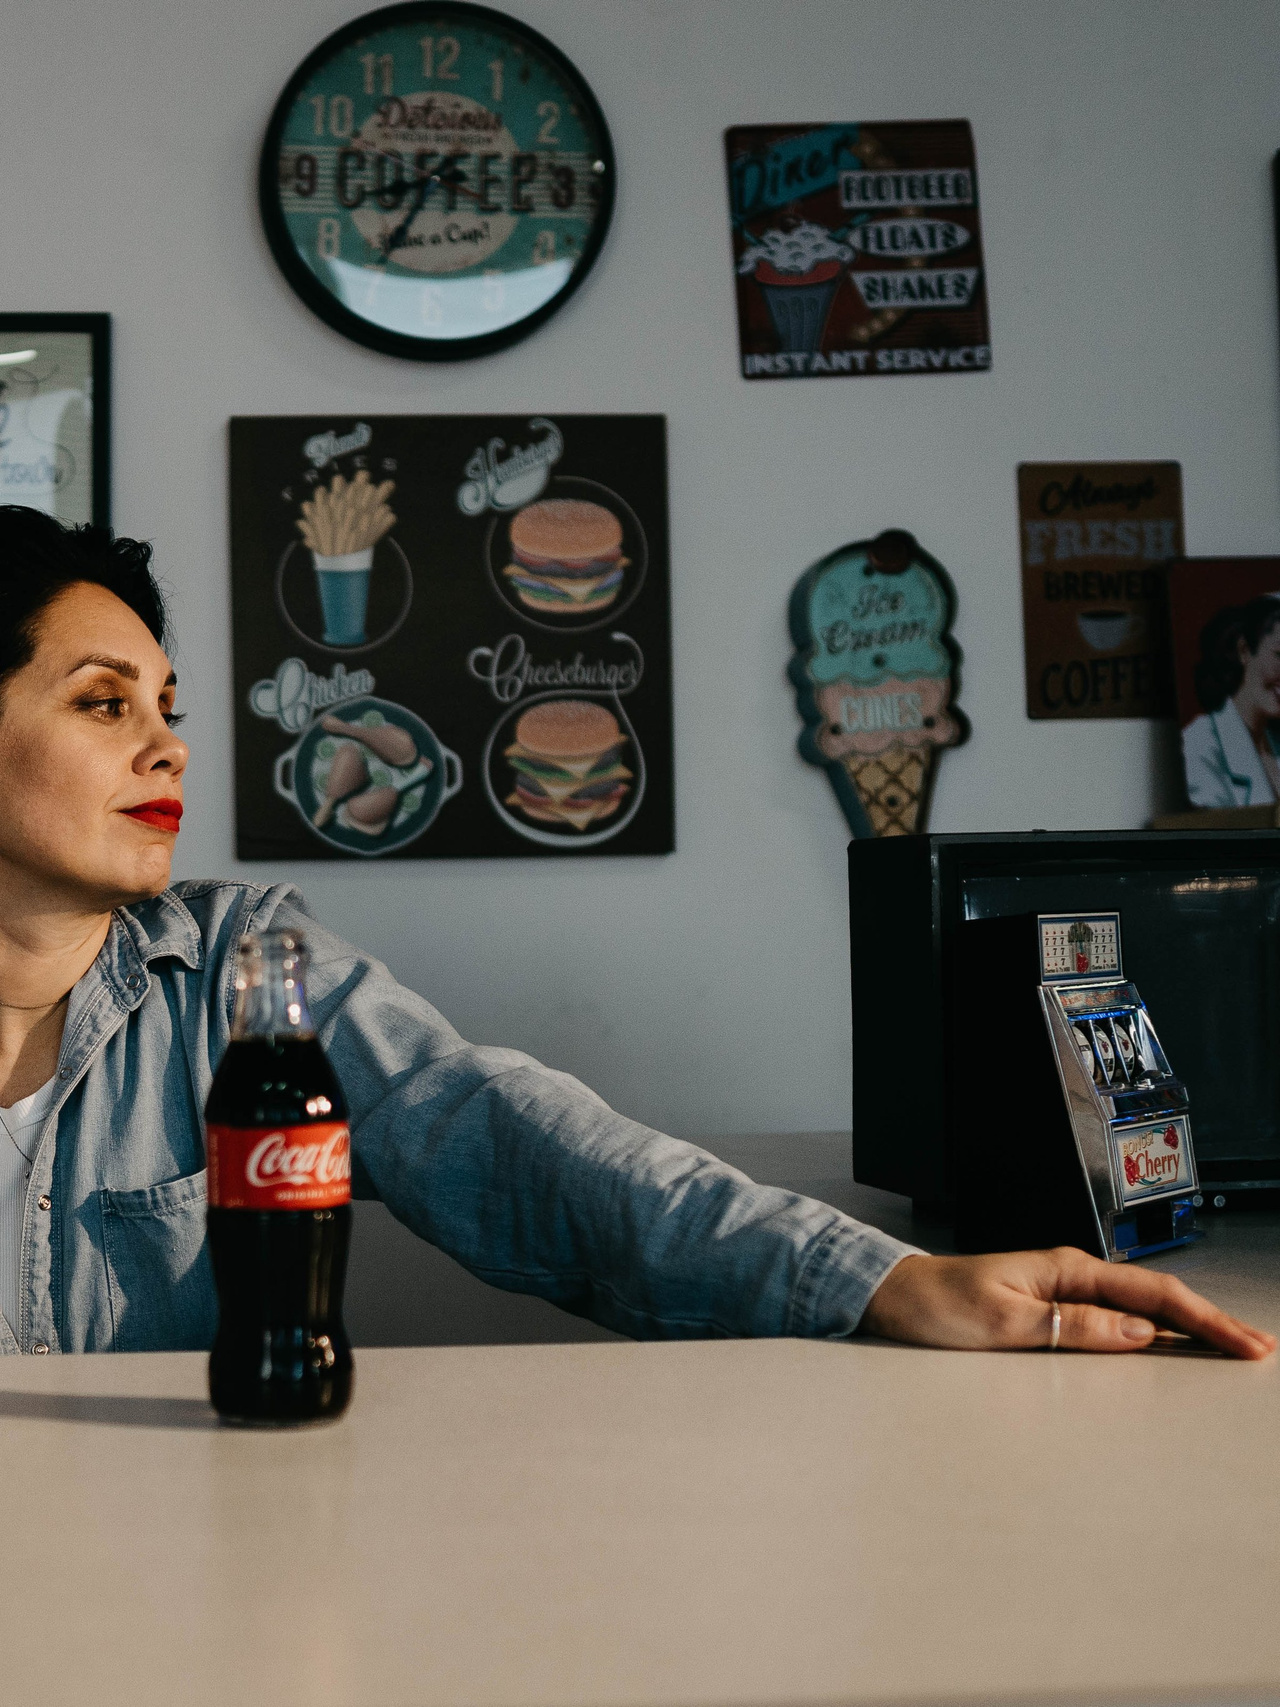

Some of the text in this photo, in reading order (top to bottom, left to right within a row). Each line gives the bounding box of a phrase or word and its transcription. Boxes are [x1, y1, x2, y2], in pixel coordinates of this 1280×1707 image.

[361, 54, 394, 95] 11
[420, 36, 461, 80] 12
[489, 59, 505, 100] 1
[310, 95, 353, 138] 10
[537, 101, 562, 144] 2
[294, 154, 317, 197] 9
[551, 166, 576, 209] 3
[733, 132, 853, 218] Diner
[316, 218, 342, 261] 8
[861, 223, 959, 251] FLOATS
[863, 273, 969, 301] SHAKES
[745, 344, 990, 375] INSTANT SERVICE
[1040, 474, 1160, 516] Always
[1025, 519, 1177, 567] FRESH
[1044, 570, 1166, 601] BREWED
[467, 631, 644, 702] Cheeseburger
[1041, 656, 1160, 712] COFFE
[1136, 1150, 1180, 1180] Cherry
